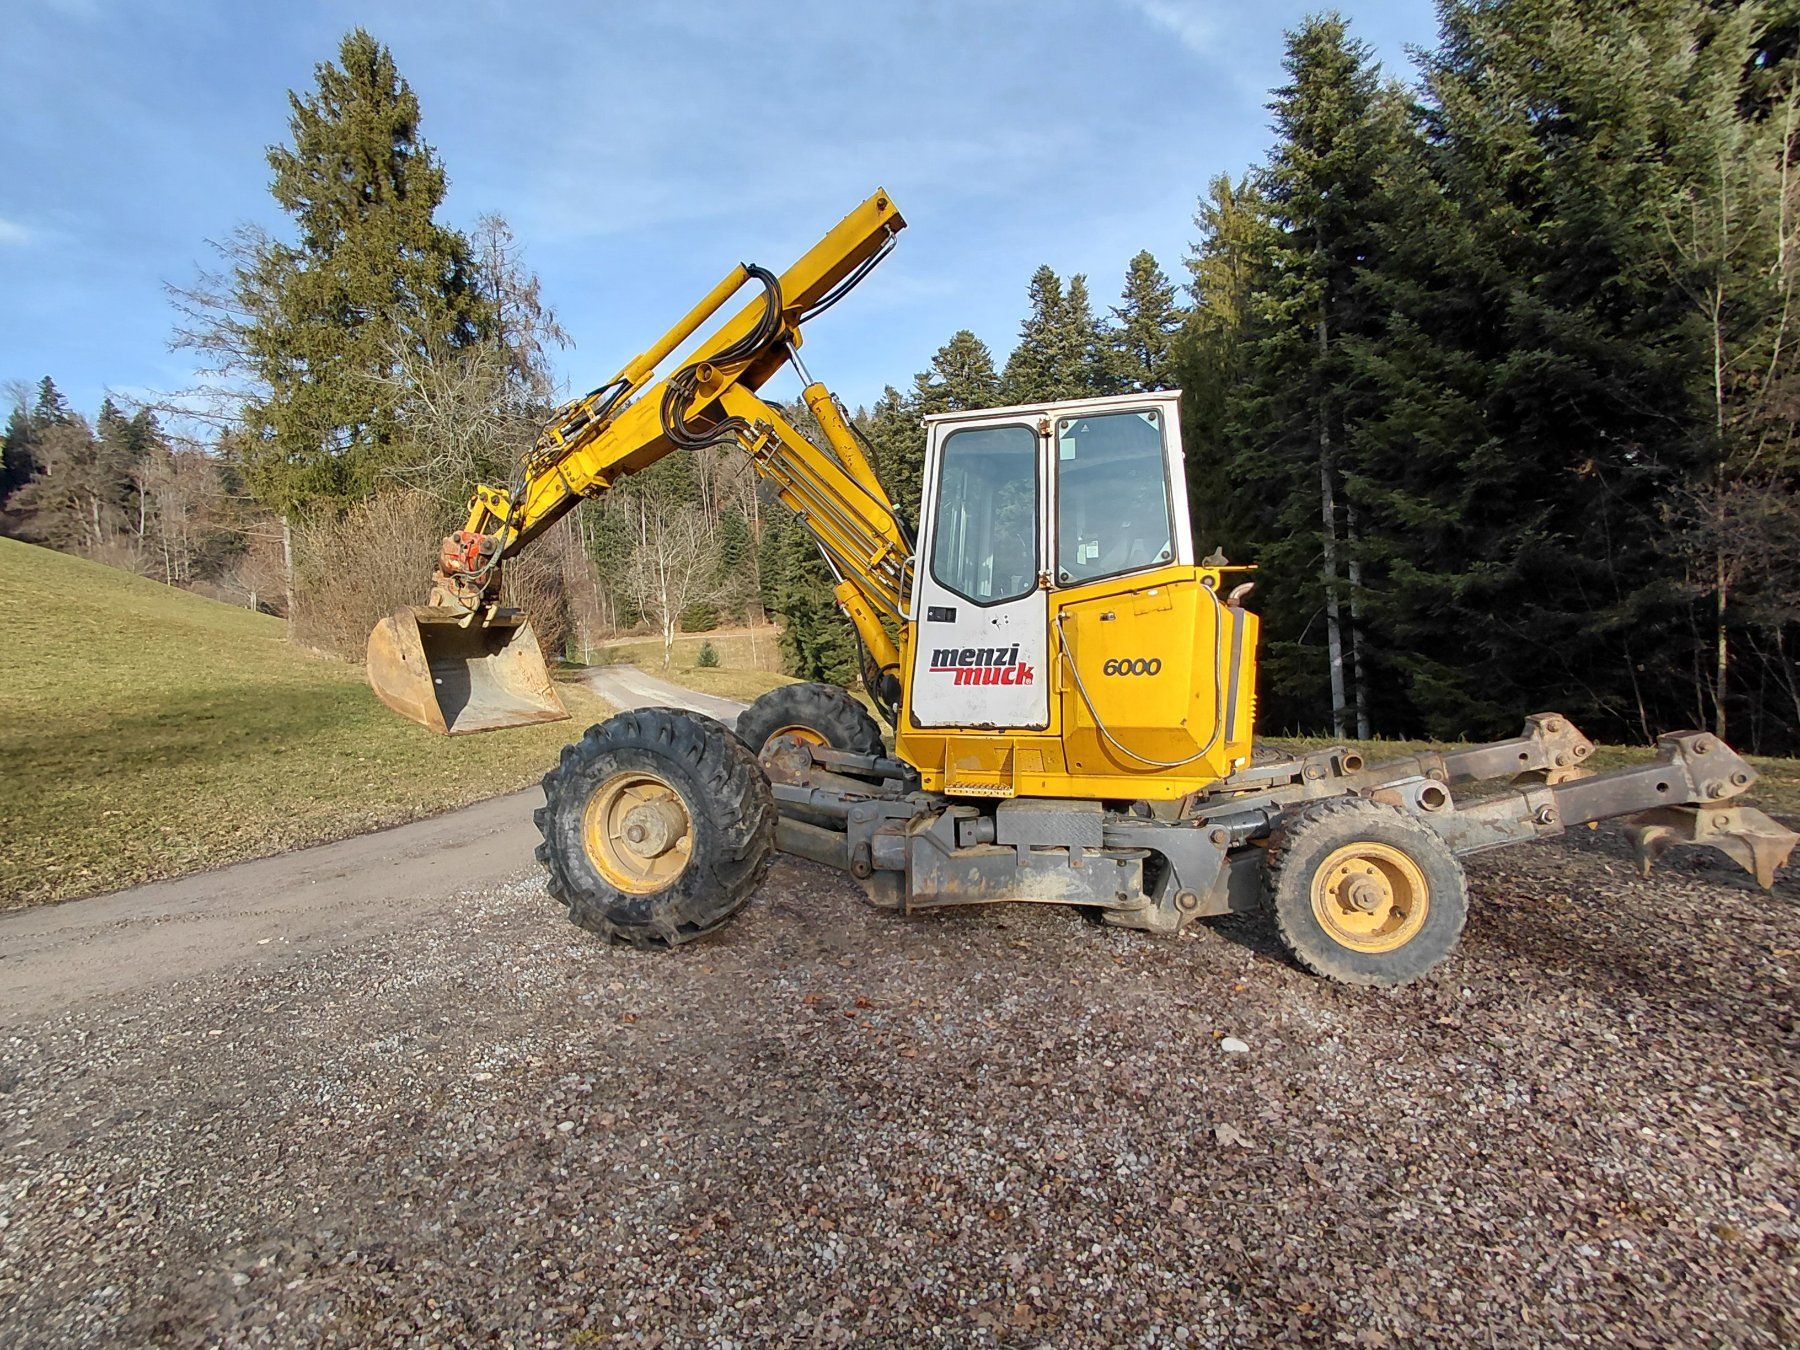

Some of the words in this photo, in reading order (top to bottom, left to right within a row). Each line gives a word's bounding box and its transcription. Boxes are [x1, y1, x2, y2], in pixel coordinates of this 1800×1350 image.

[930, 643, 1020, 667] menzi
[953, 662, 1034, 685] muck
[1103, 658, 1162, 676] 6000
